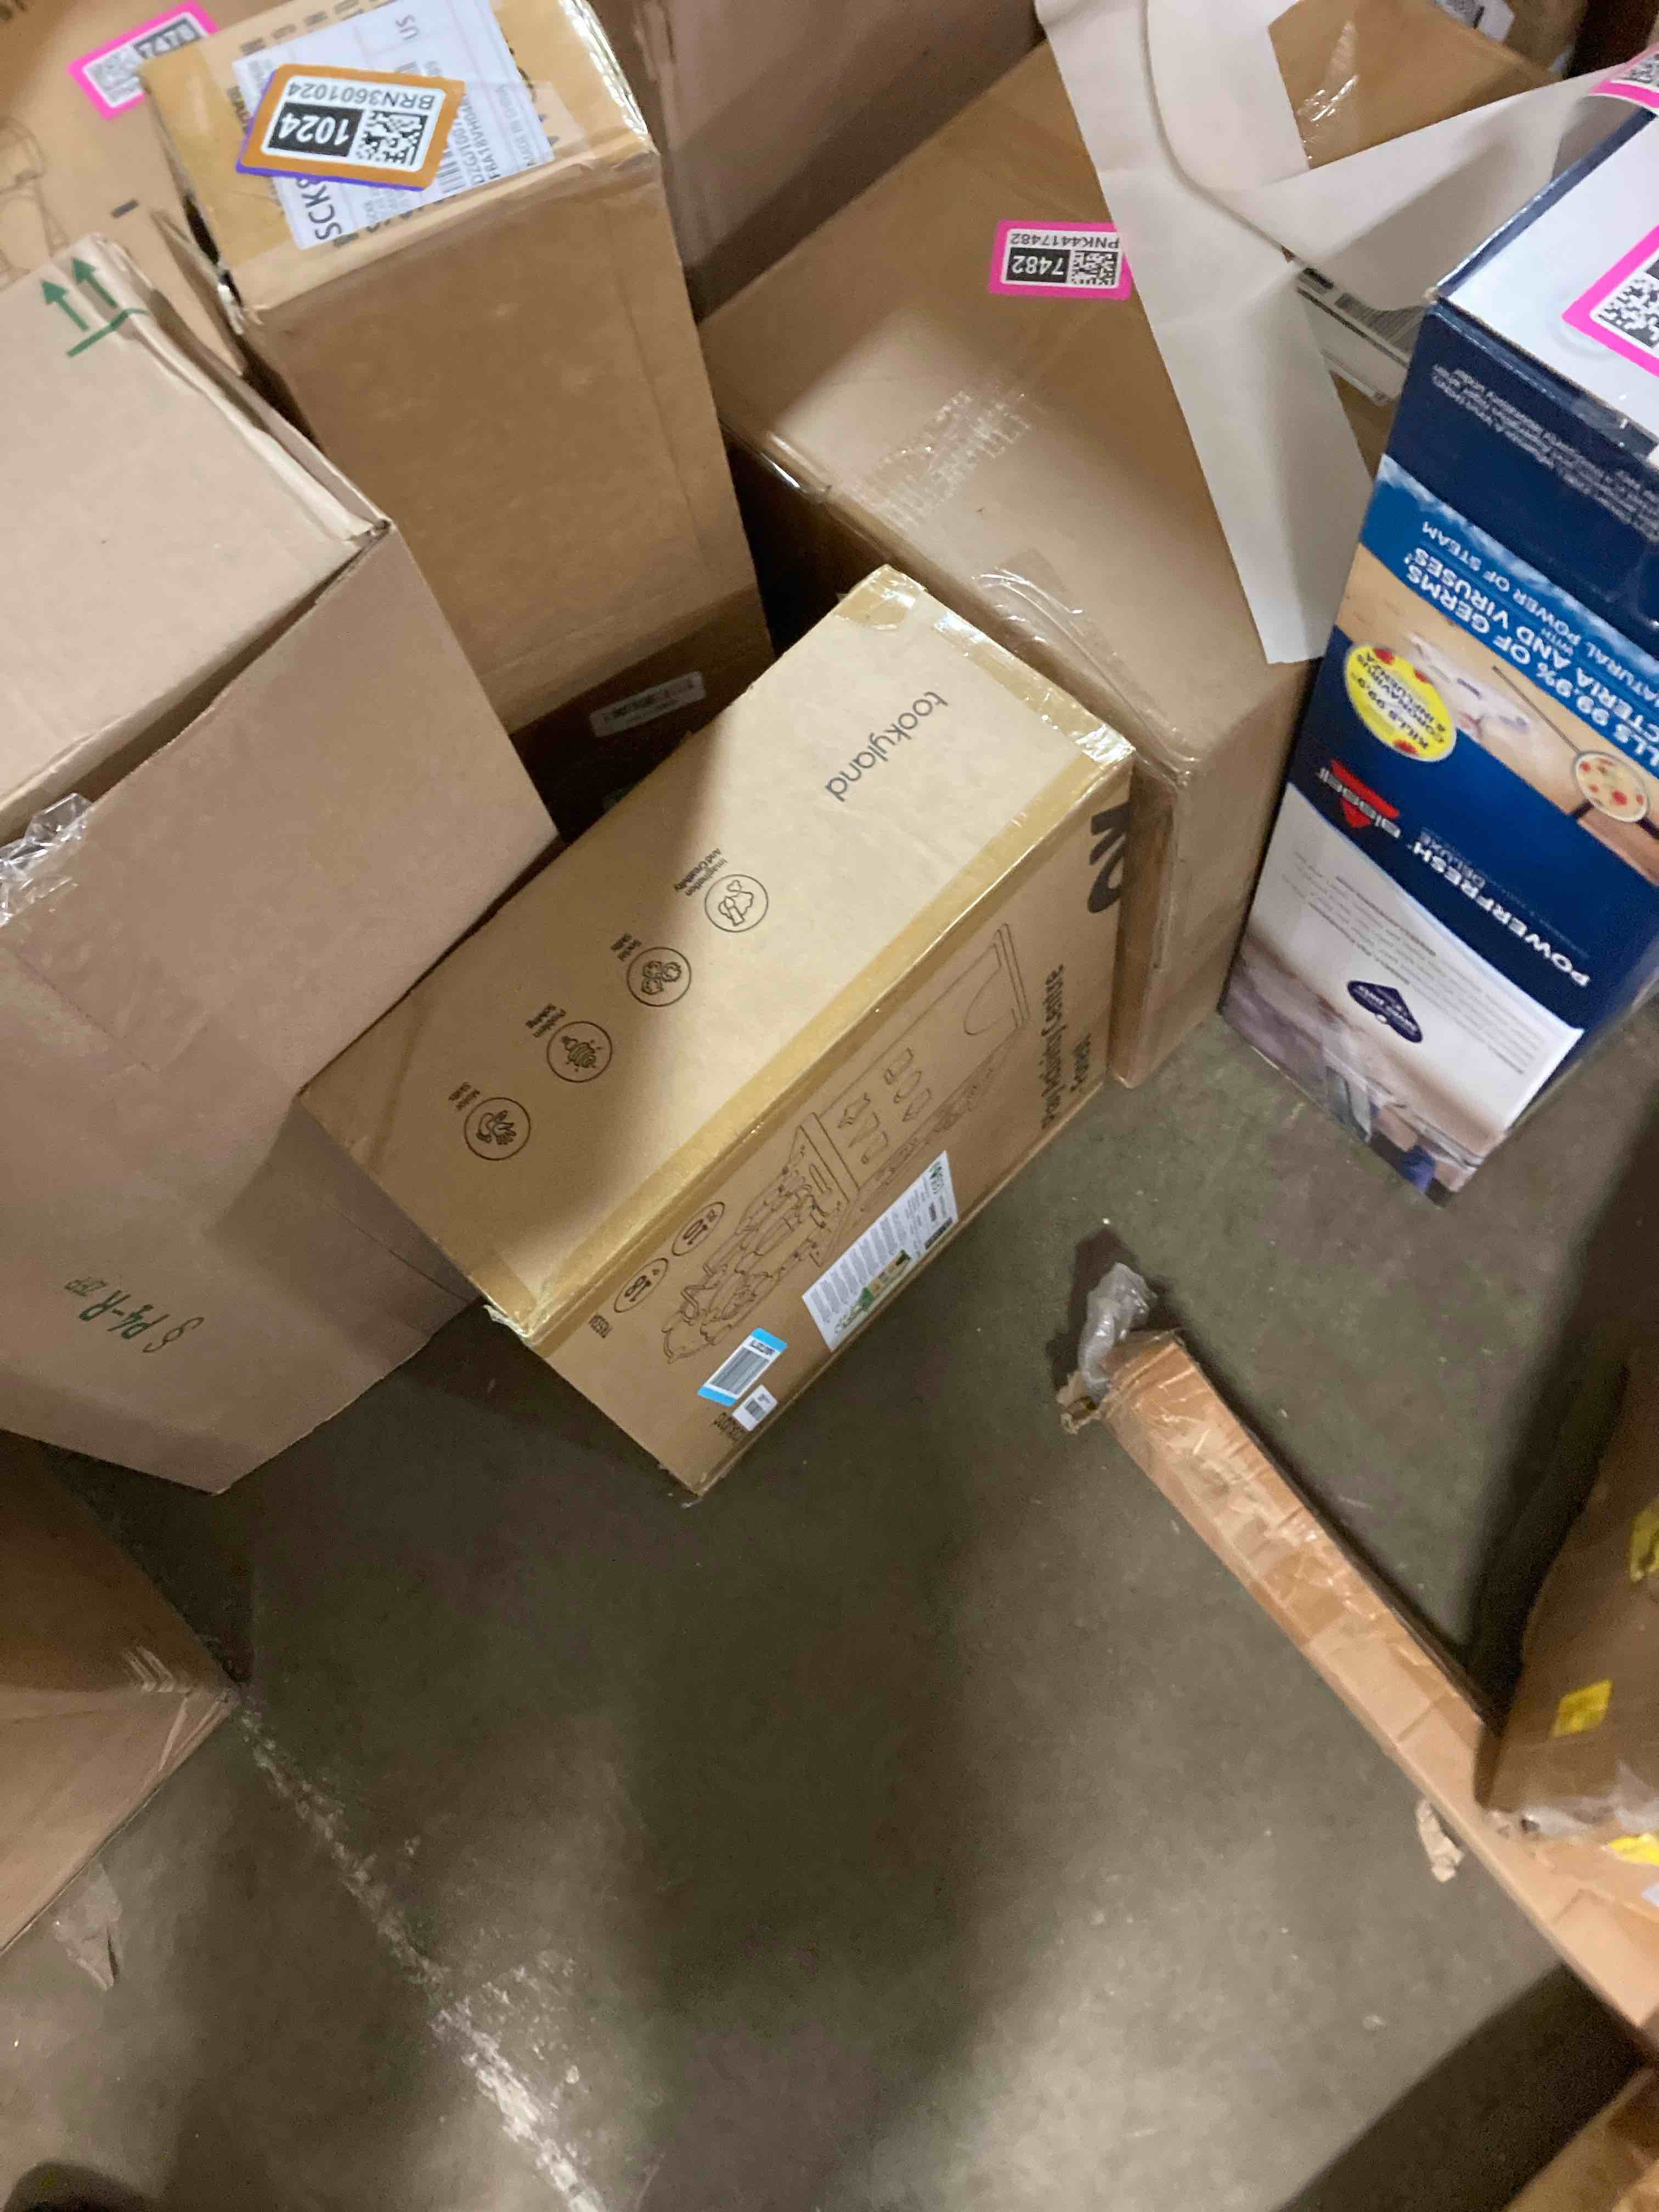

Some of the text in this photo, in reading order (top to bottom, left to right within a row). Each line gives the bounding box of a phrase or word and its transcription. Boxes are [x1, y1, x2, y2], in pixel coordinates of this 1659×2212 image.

[289, 82, 436, 110] BRN3601024
[278, 112, 350, 146] 1024
[1011, 233, 1120, 249] PNK4417482
[1012, 254, 1065, 276] 7482
[1422, 522, 1482, 572] STEAM
[1482, 566, 1513, 594] OF
[1510, 587, 1583, 646] POWER
[1492, 629, 1534, 667] OF
[1513, 622, 1572, 673] AND
[1531, 659, 1613, 728] 99.9%
[823, 692, 948, 801] tookyland
[1408, 839, 1593, 988] POWERFRESH
[624, 1275, 652, 1302] 18
